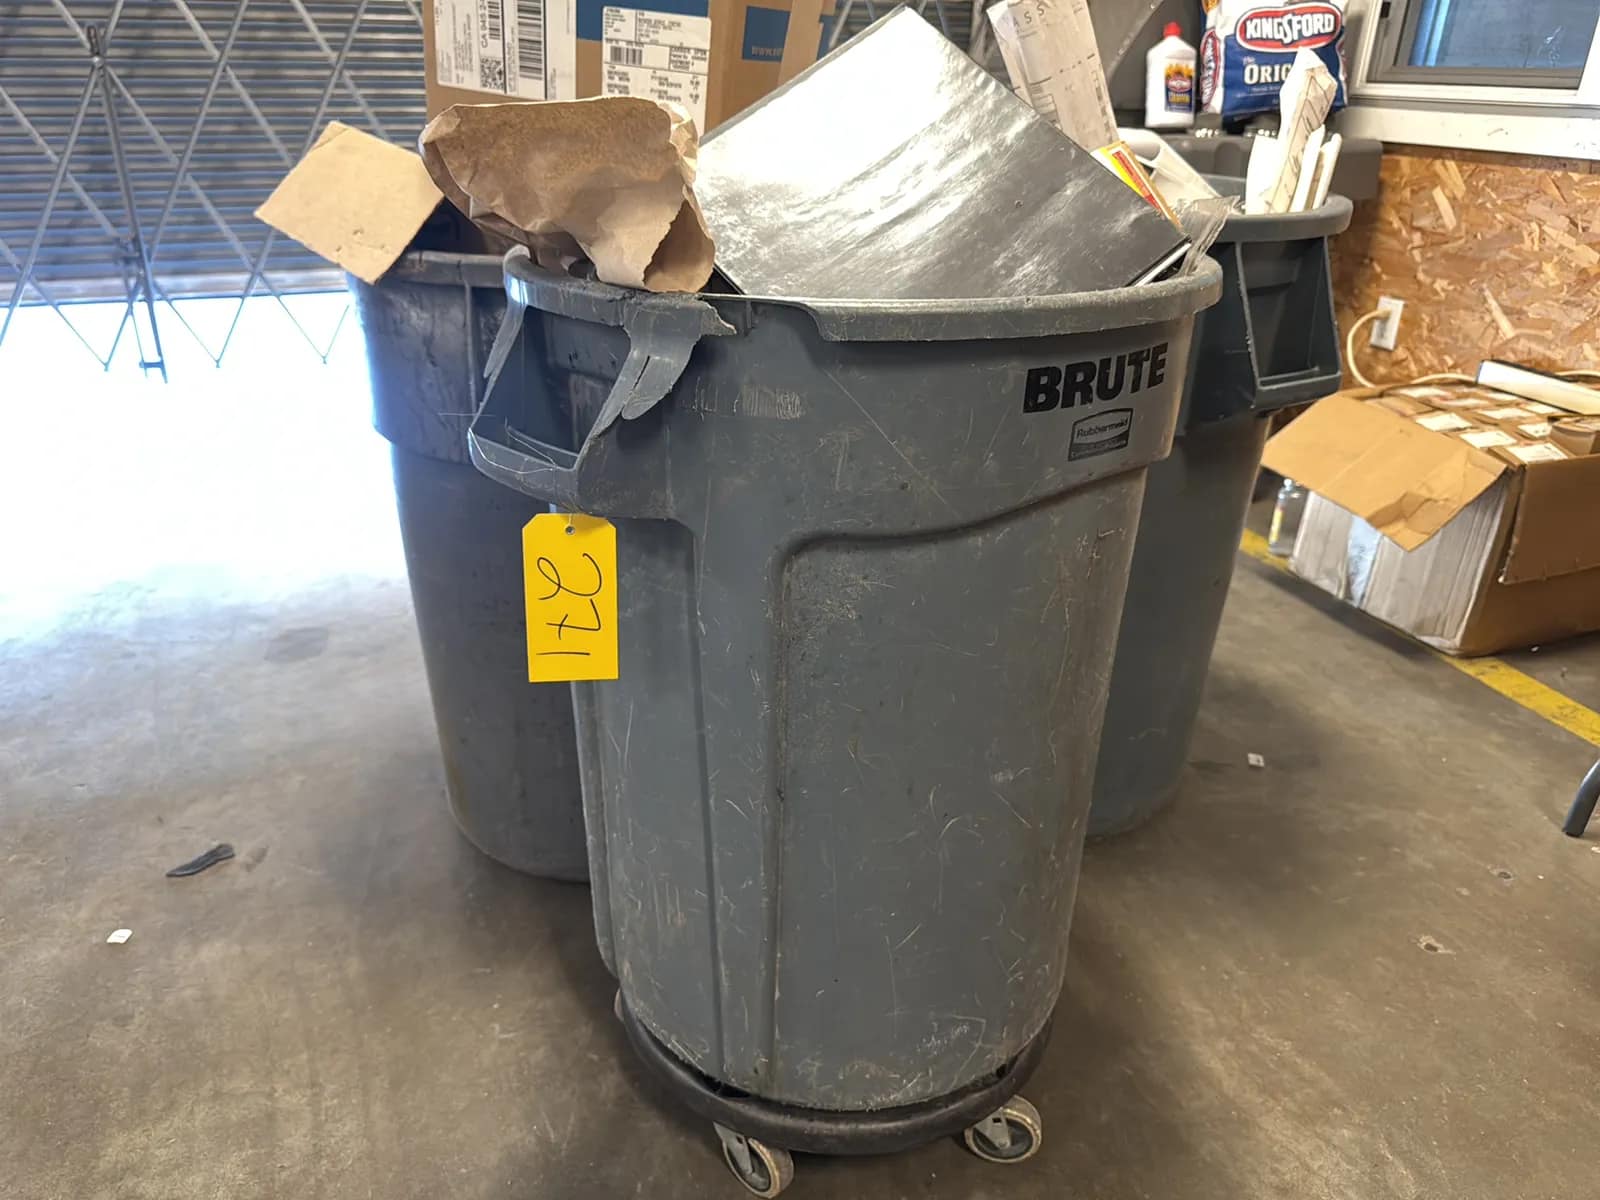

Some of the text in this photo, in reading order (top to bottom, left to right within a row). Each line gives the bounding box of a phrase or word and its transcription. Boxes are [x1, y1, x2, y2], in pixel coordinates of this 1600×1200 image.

[1245, 12, 1336, 45] KINGSFORD
[1022, 342, 1169, 414] BRUTE
[1076, 417, 1129, 438] Rubbermaid
[536, 552, 602, 656] 271
